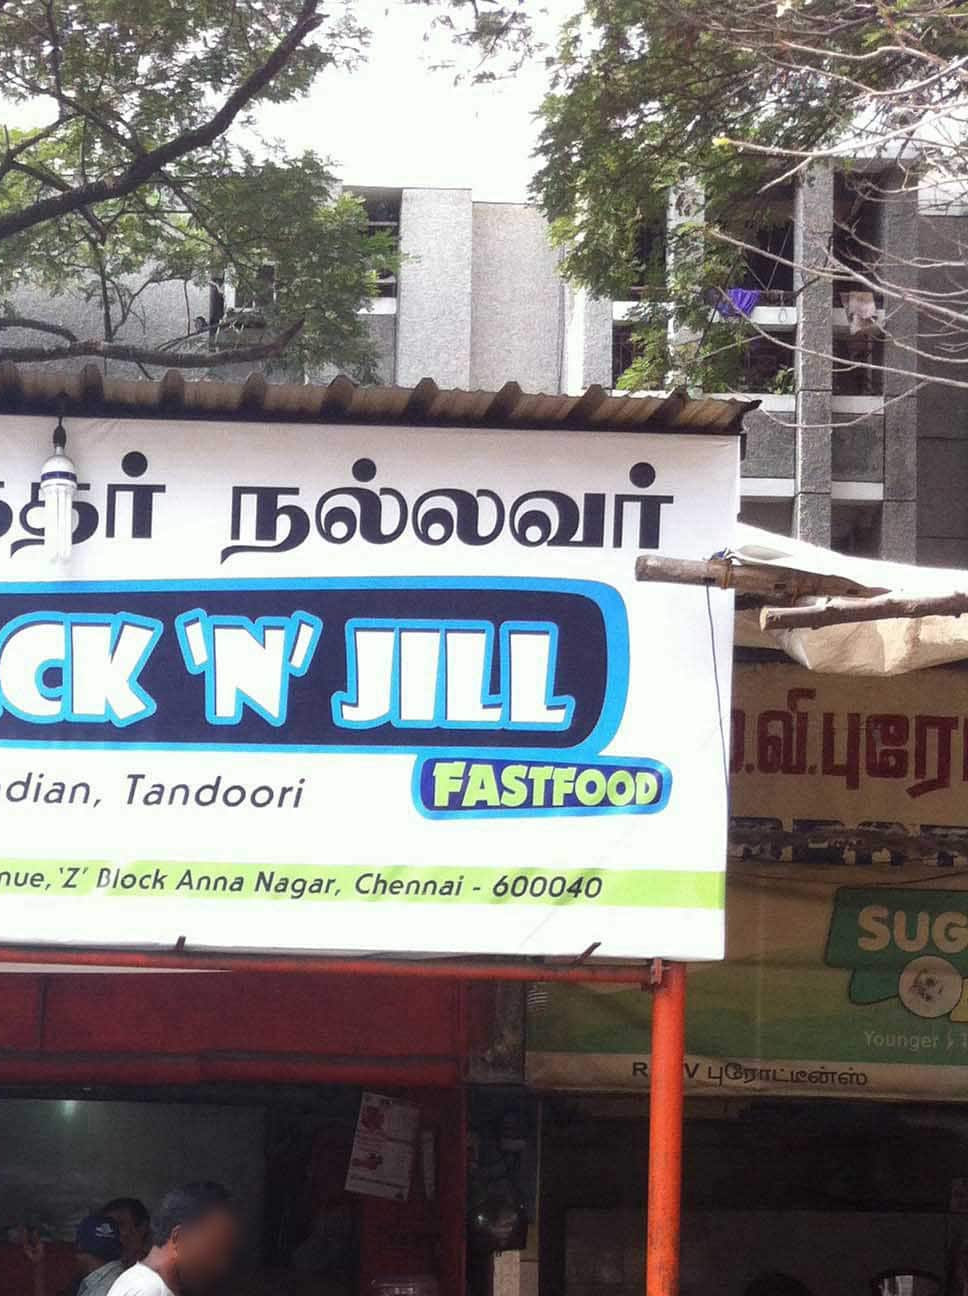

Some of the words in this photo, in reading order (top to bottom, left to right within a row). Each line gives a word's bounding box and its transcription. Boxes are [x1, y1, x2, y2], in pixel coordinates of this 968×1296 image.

[220, 458, 674, 564] நல்லவர்
[332, 619, 575, 731] JILL
[127, 775, 306, 808] Tandoori
[432, 760, 659, 808] FASTFOOD
[96, 867, 168, 890] Block
[175, 869, 244, 892] Anna
[254, 871, 340, 899] Nagar,
[355, 873, 463, 896] Chennai
[492, 875, 603, 898] 600040
[864, 1031, 939, 1052] Younger
